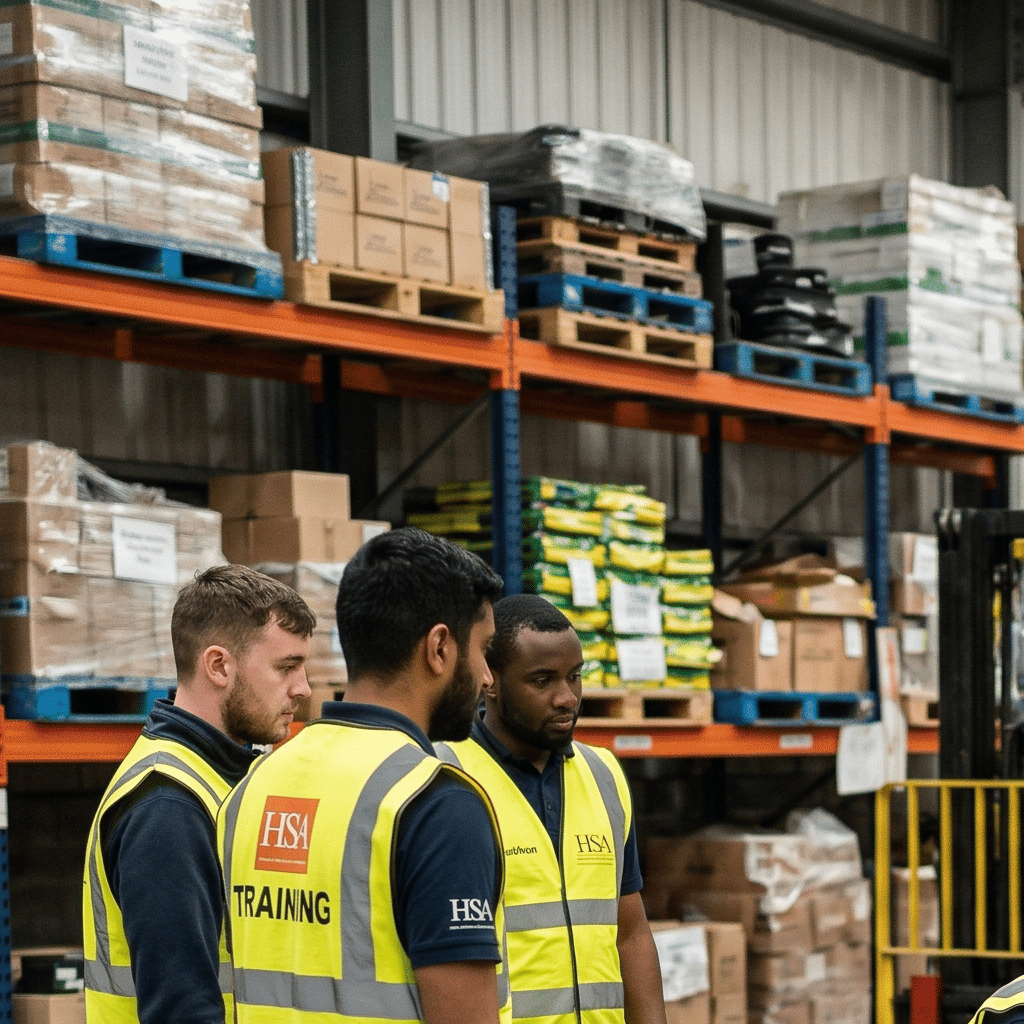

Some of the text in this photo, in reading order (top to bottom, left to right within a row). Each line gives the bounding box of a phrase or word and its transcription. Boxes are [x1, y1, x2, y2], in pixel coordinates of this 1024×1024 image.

[259, 811, 309, 850] HSA
[574, 834, 613, 854] HSA
[449, 898, 494, 922] HSA
